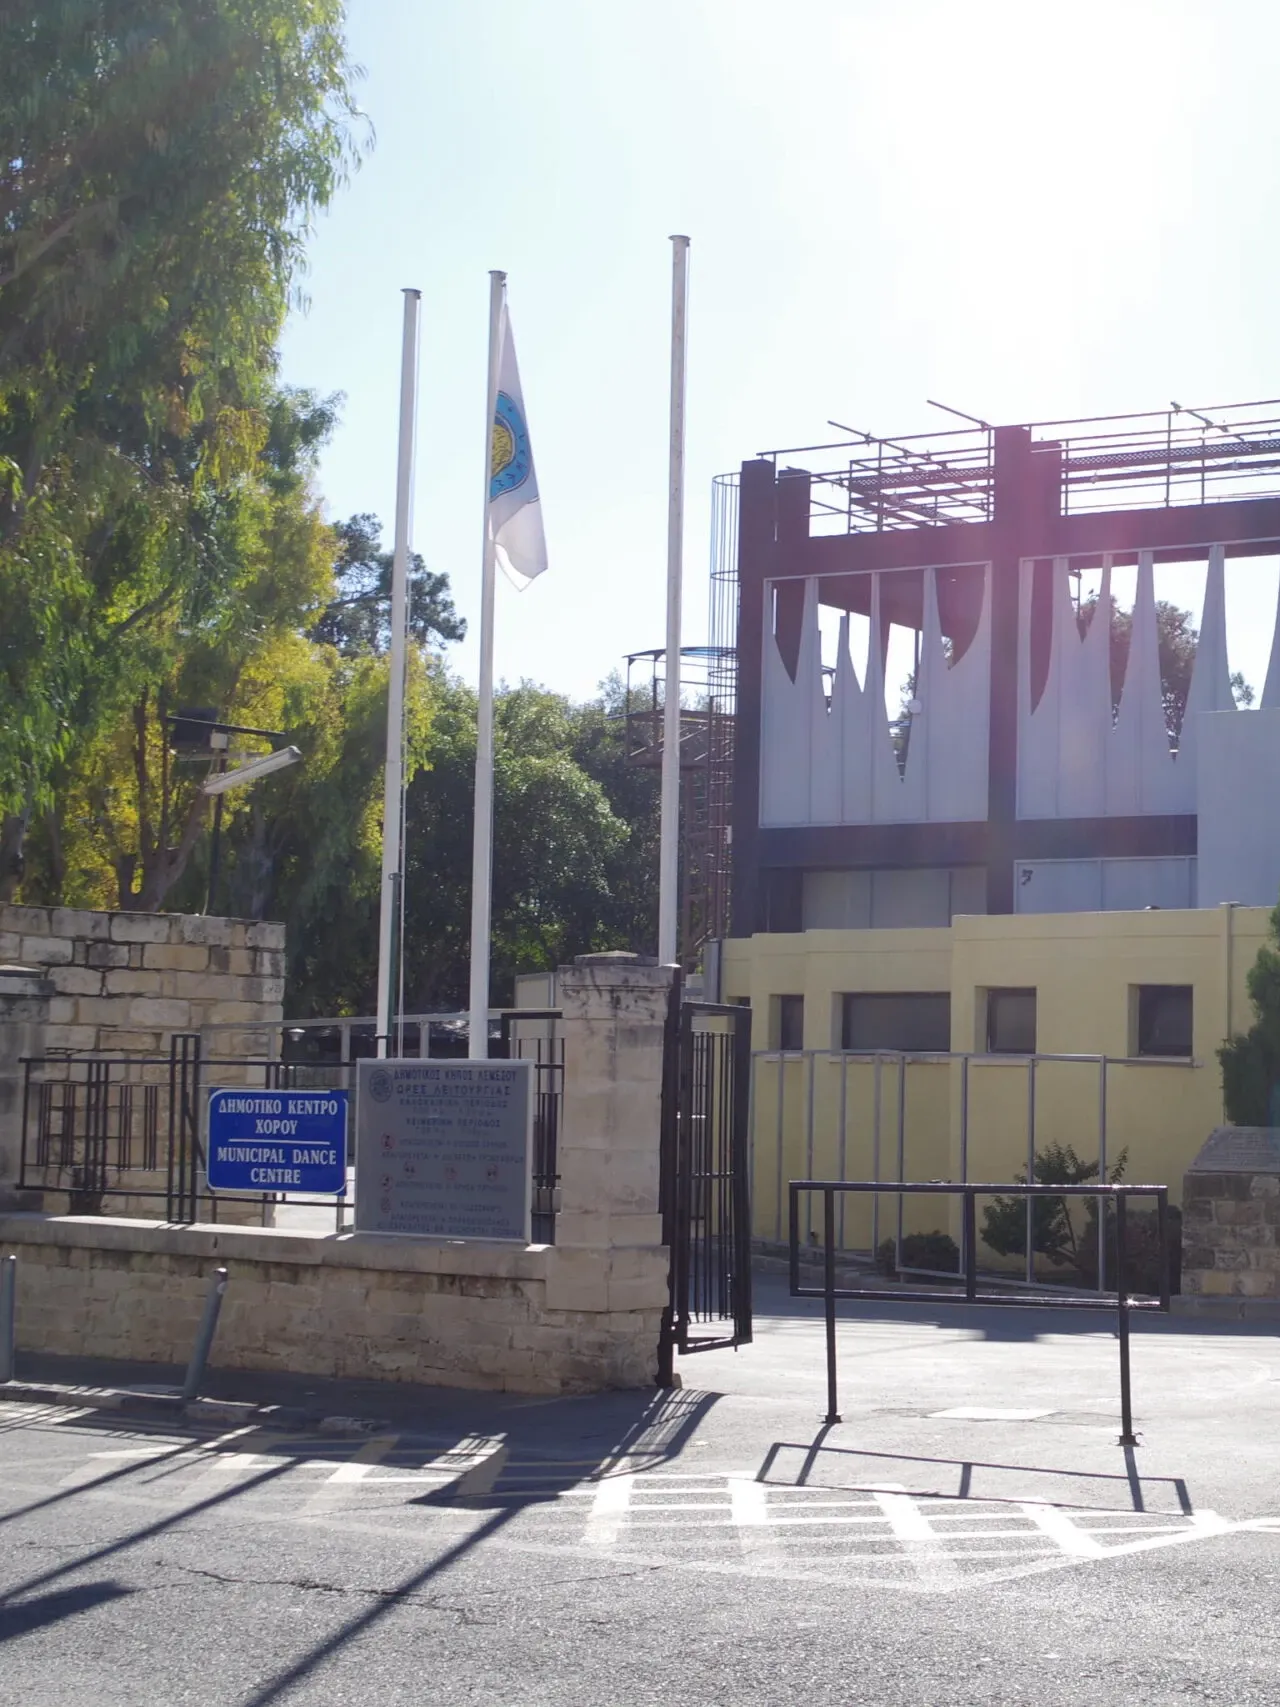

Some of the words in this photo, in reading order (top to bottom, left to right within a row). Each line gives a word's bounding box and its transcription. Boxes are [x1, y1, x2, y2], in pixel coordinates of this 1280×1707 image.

[394, 1069, 440, 1080] ΔΗΜΟΤΙΚΟΣ
[445, 1070, 472, 1081] ΚΗΠΟΣ
[397, 1084, 427, 1095] ΩΡΕΣ
[434, 1085, 511, 1096] ΛΕΙΤΟΥΡΓΙΑΣ
[219, 1098, 282, 1115] ΔΗΜΟΤΙΚΟ
[288, 1100, 338, 1115] ΚΕΝΤΡΟ
[255, 1119, 298, 1135] ΧΟΡΟΥ
[217, 1146, 285, 1164] MUNICIPAL
[292, 1150, 336, 1165] DANCE
[250, 1167, 301, 1184] CENTRE
